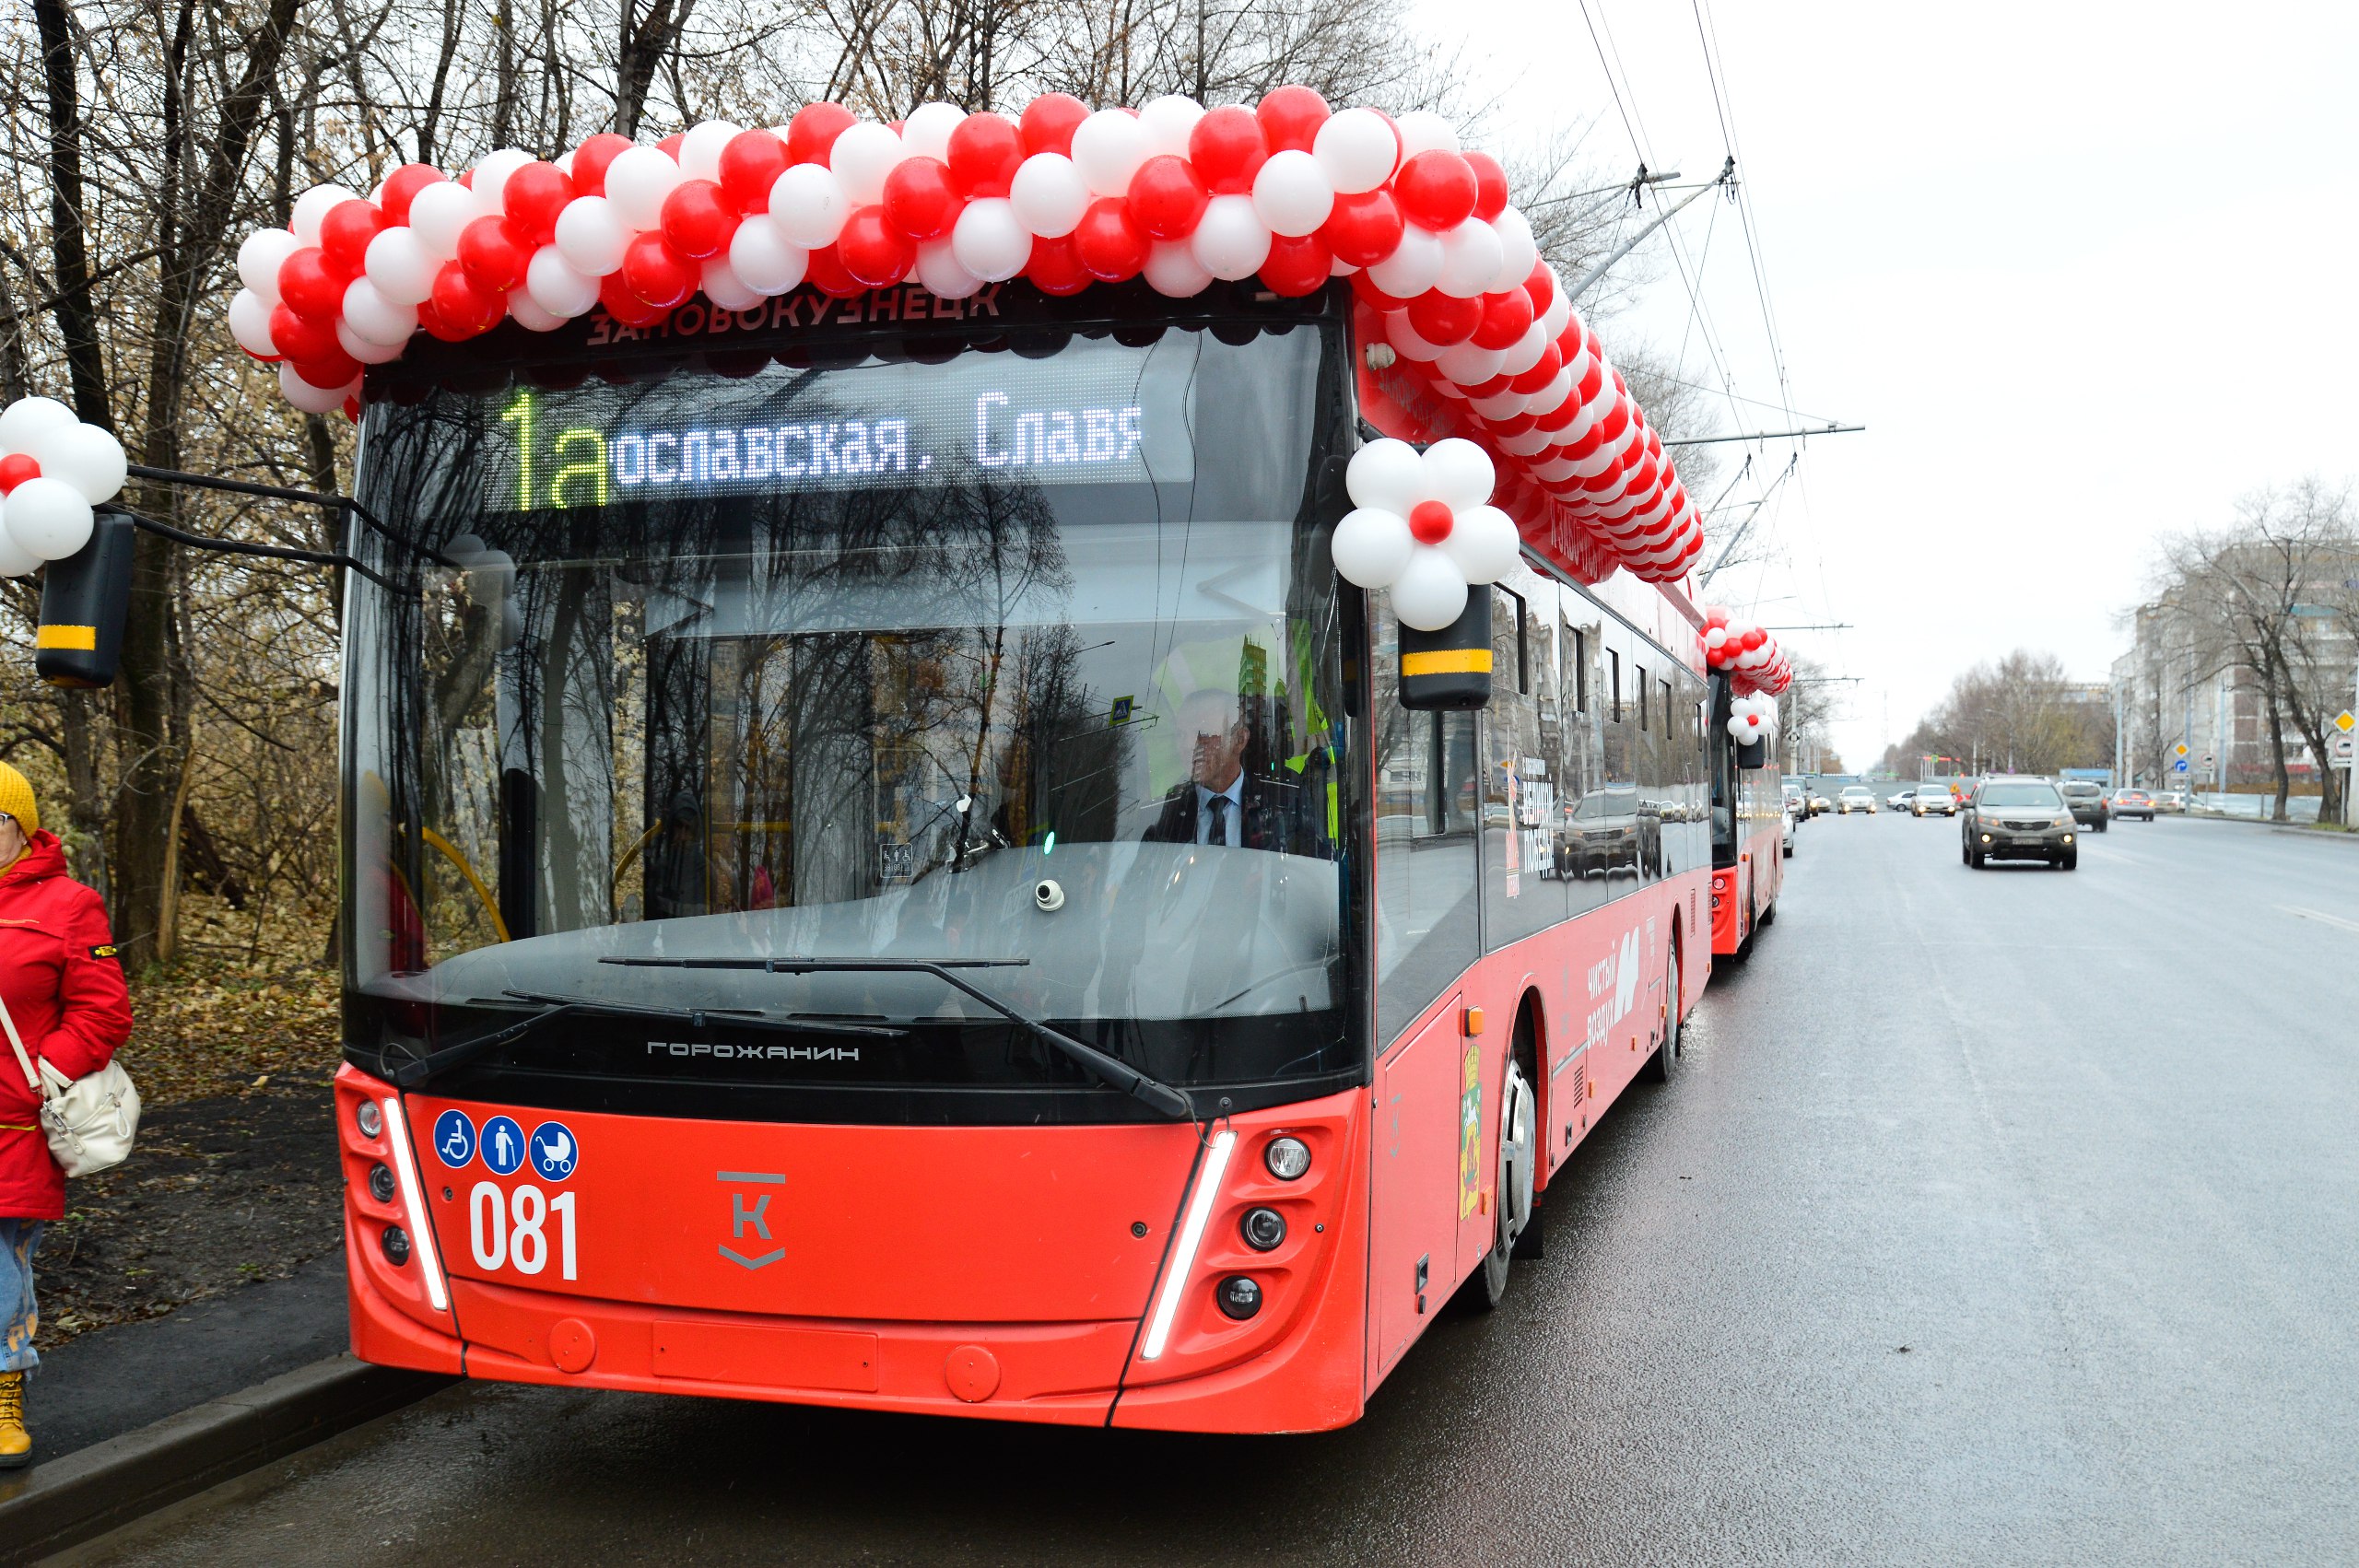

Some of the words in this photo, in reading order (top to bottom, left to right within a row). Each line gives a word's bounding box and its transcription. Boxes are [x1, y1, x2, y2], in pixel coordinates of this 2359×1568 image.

[608, 419, 932, 485] ославская,
[1523, 773, 1554, 825] ВЕЛИКОЙ
[1524, 828, 1555, 879] ПОБЕДЫ
[1588, 940, 1616, 1000] ЧИСТЫЙ
[1587, 997, 1614, 1050] ВОЗДУХ
[647, 1041, 860, 1061] ГОРОЖАНИН
[469, 1181, 577, 1281] 081
